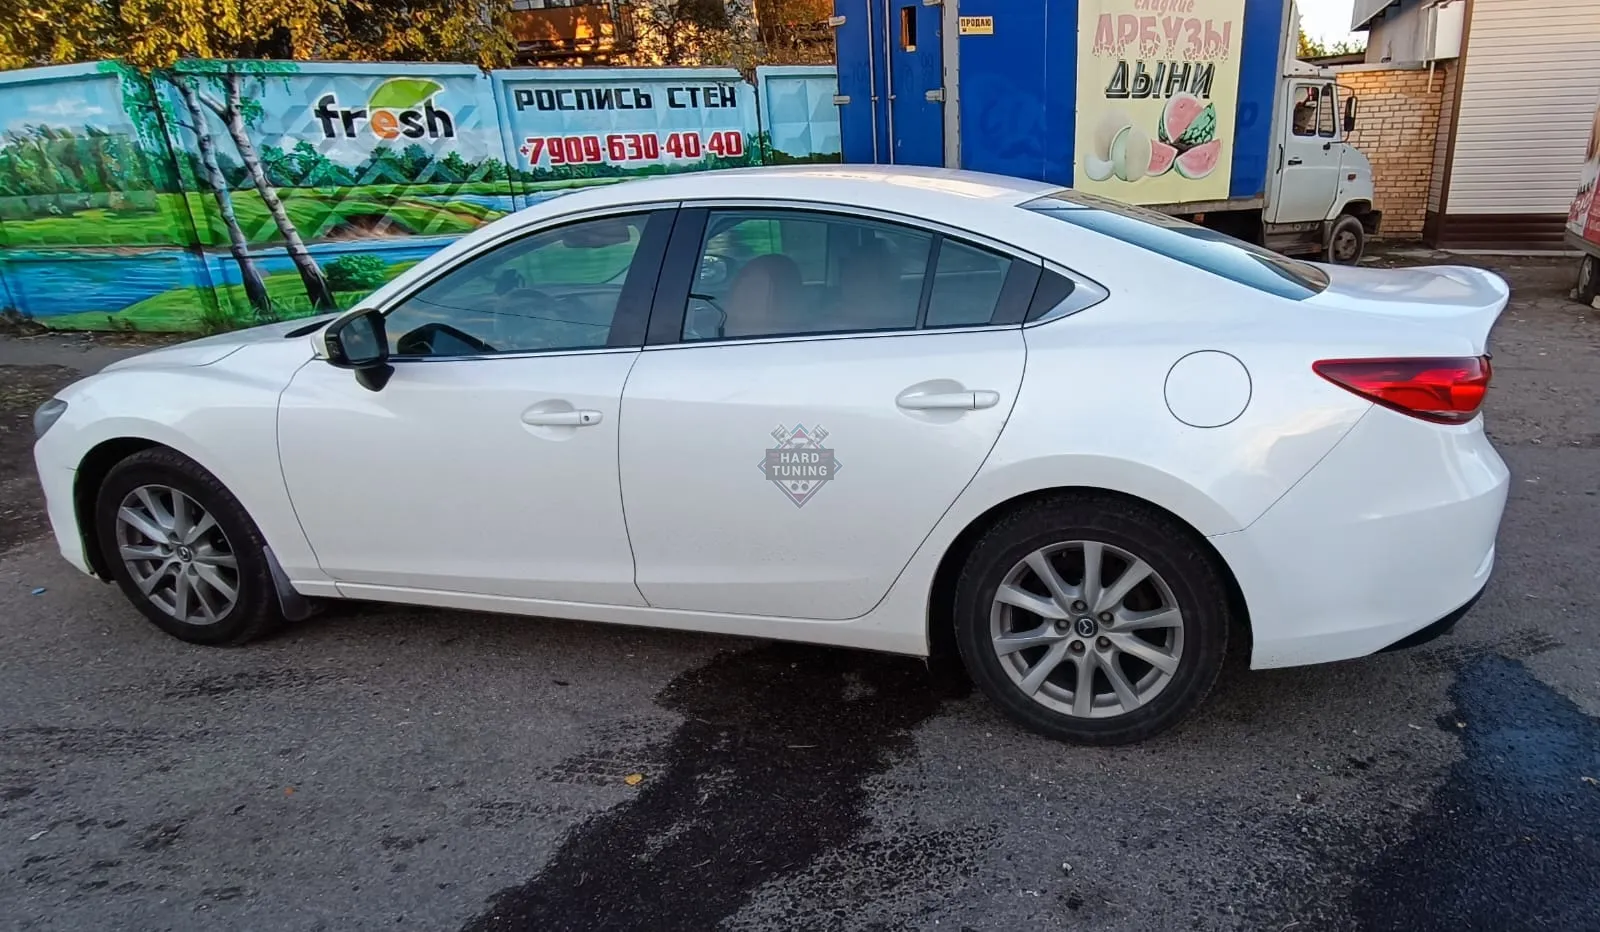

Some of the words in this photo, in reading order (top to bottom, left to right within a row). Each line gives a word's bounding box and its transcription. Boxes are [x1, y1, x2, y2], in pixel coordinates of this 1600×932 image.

[960, 18, 992, 27] ПРОДАЮ
[1092, 13, 1232, 61] АРБУЗЫ
[514, 88, 653, 111] РОСПИСЬ
[667, 86, 738, 108] СТЕН
[1105, 60, 1216, 99] ДЫНИ
[313, 94, 455, 139] fresh
